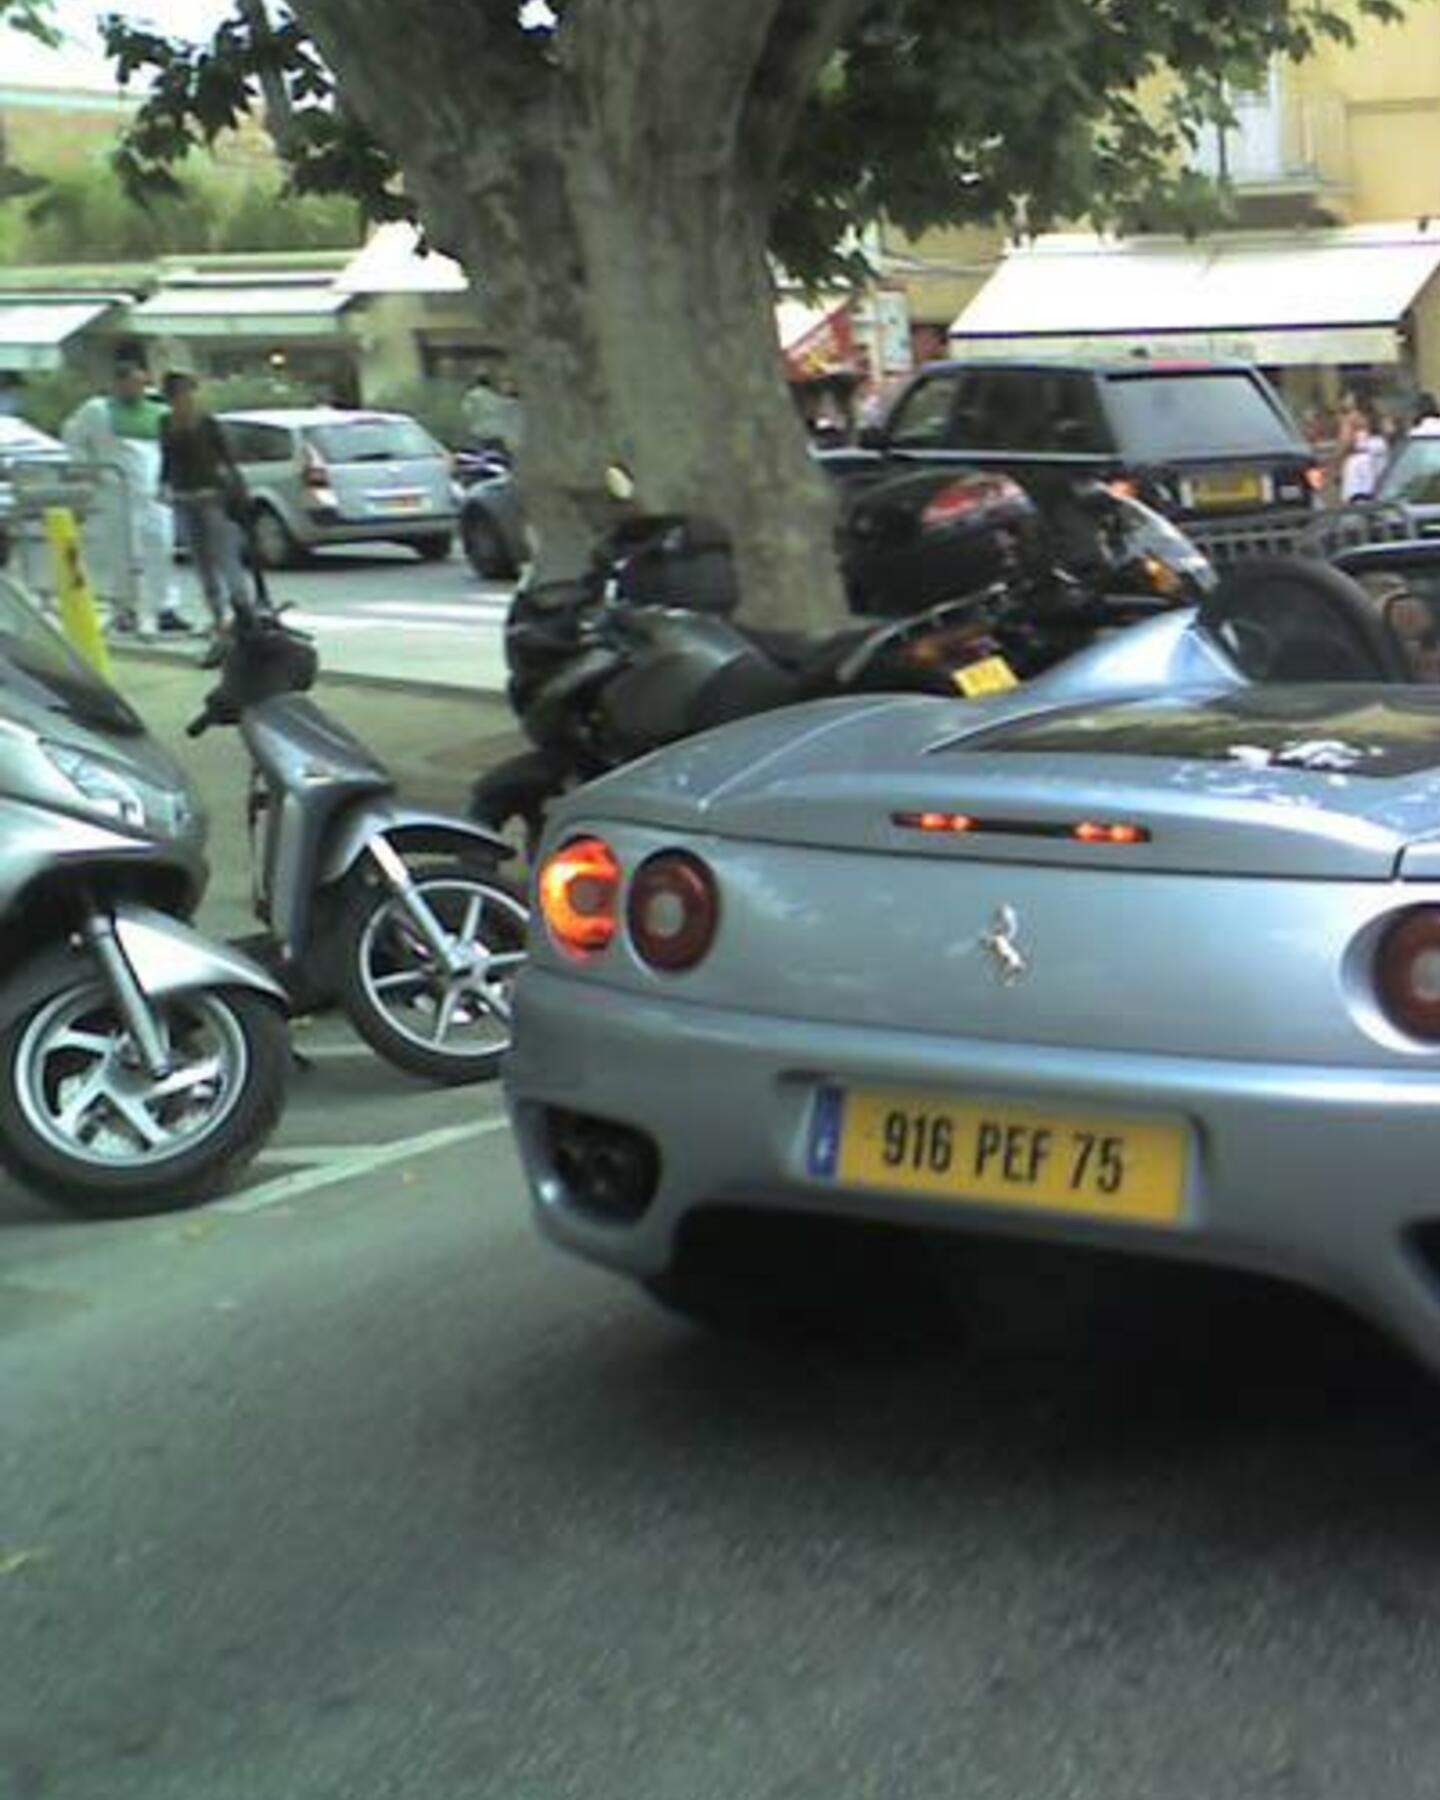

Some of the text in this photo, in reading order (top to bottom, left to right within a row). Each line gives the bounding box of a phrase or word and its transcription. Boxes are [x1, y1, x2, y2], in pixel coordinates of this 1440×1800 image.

[882, 1110, 1124, 1192] 916 PEF 75
